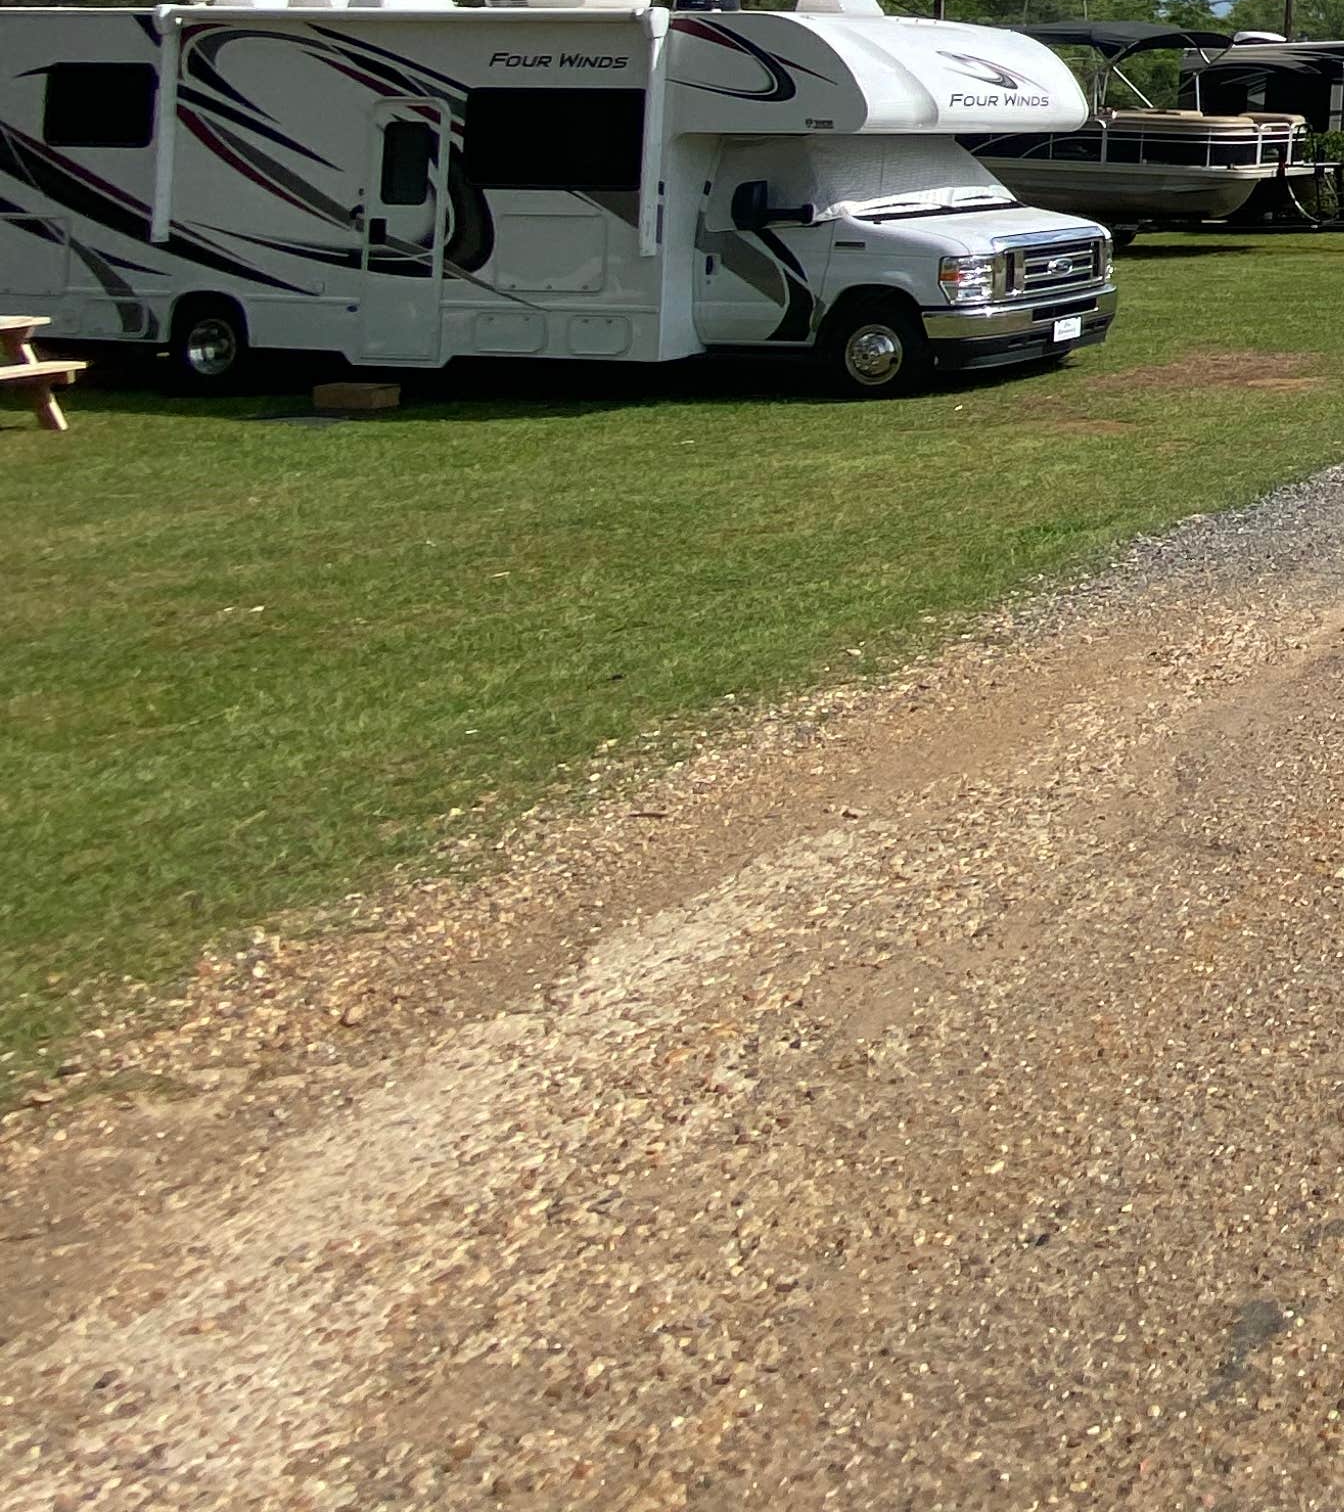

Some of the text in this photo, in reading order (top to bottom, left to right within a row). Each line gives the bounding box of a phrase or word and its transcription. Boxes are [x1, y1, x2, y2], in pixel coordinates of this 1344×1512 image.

[489, 52, 629, 69] FOUR WINDS
[949, 92, 1050, 108] FOUR WINDS
